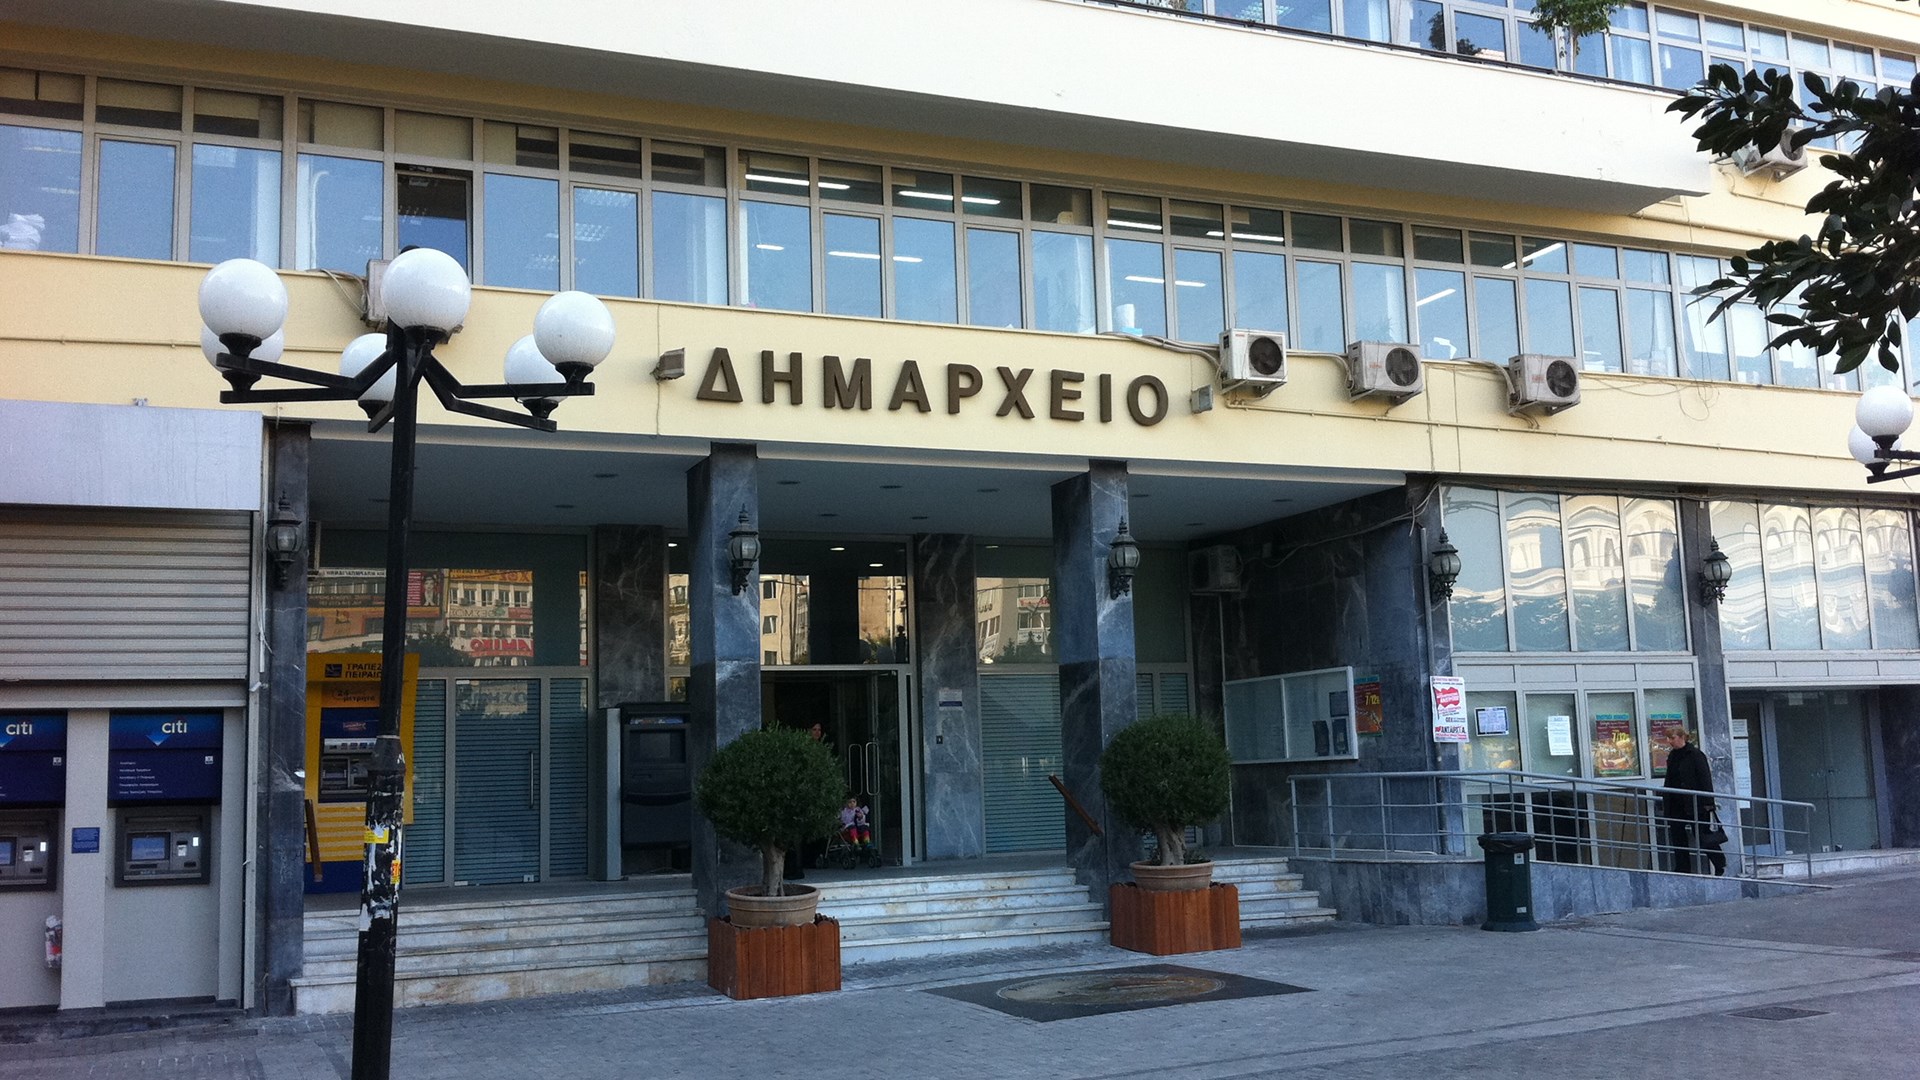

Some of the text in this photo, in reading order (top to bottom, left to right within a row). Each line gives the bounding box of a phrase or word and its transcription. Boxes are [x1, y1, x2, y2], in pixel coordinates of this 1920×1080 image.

[696, 347, 1169, 427] ΔΗΜΑΡΧΕΙΟ
[5, 722, 33, 735] citi
[161, 720, 188, 734] citi
